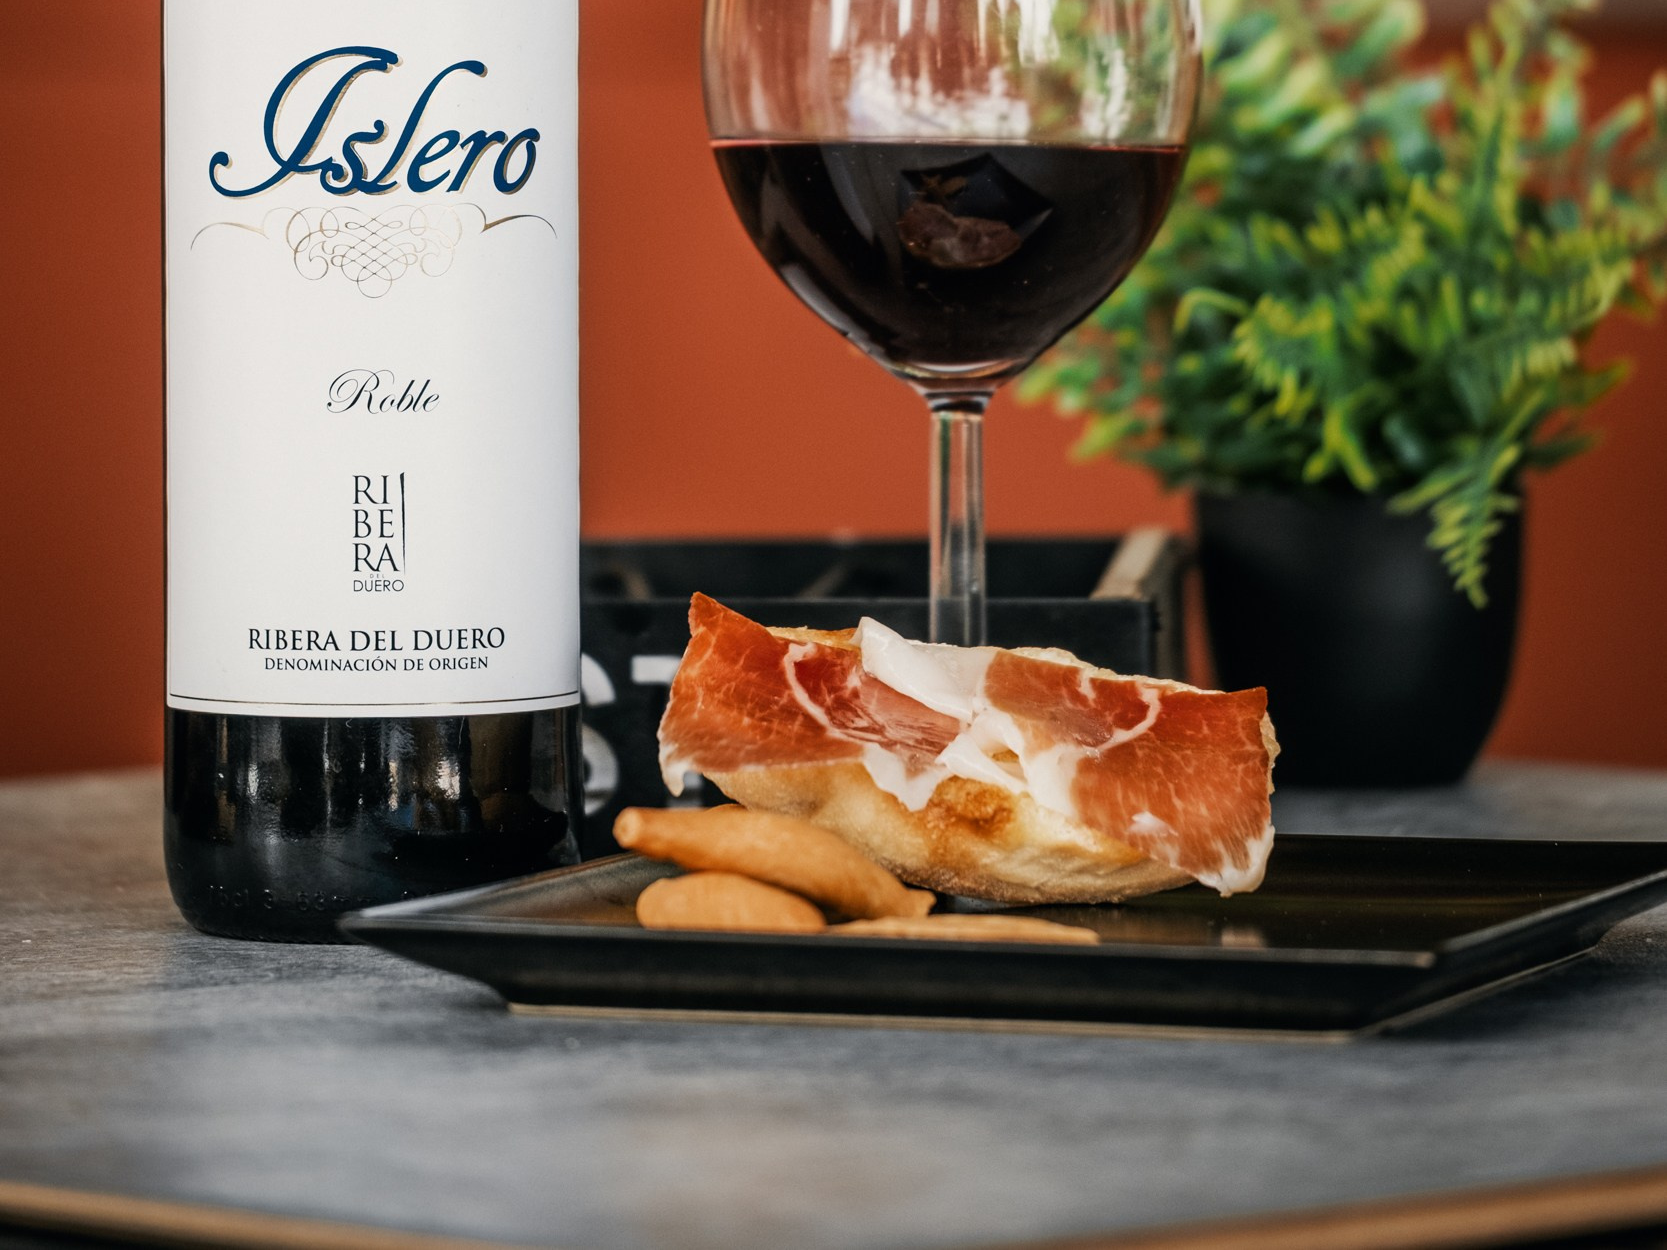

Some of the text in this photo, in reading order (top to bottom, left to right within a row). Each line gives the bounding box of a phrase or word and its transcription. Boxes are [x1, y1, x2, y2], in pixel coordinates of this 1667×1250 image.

[209, 45, 543, 198] Islero
[326, 368, 440, 414] Roble
[353, 579, 405, 592] DUERO
[248, 627, 505, 651] RIBERA DEL DUERO
[264, 656, 489, 672] DENOMINACIÓN DE ORIGEN
